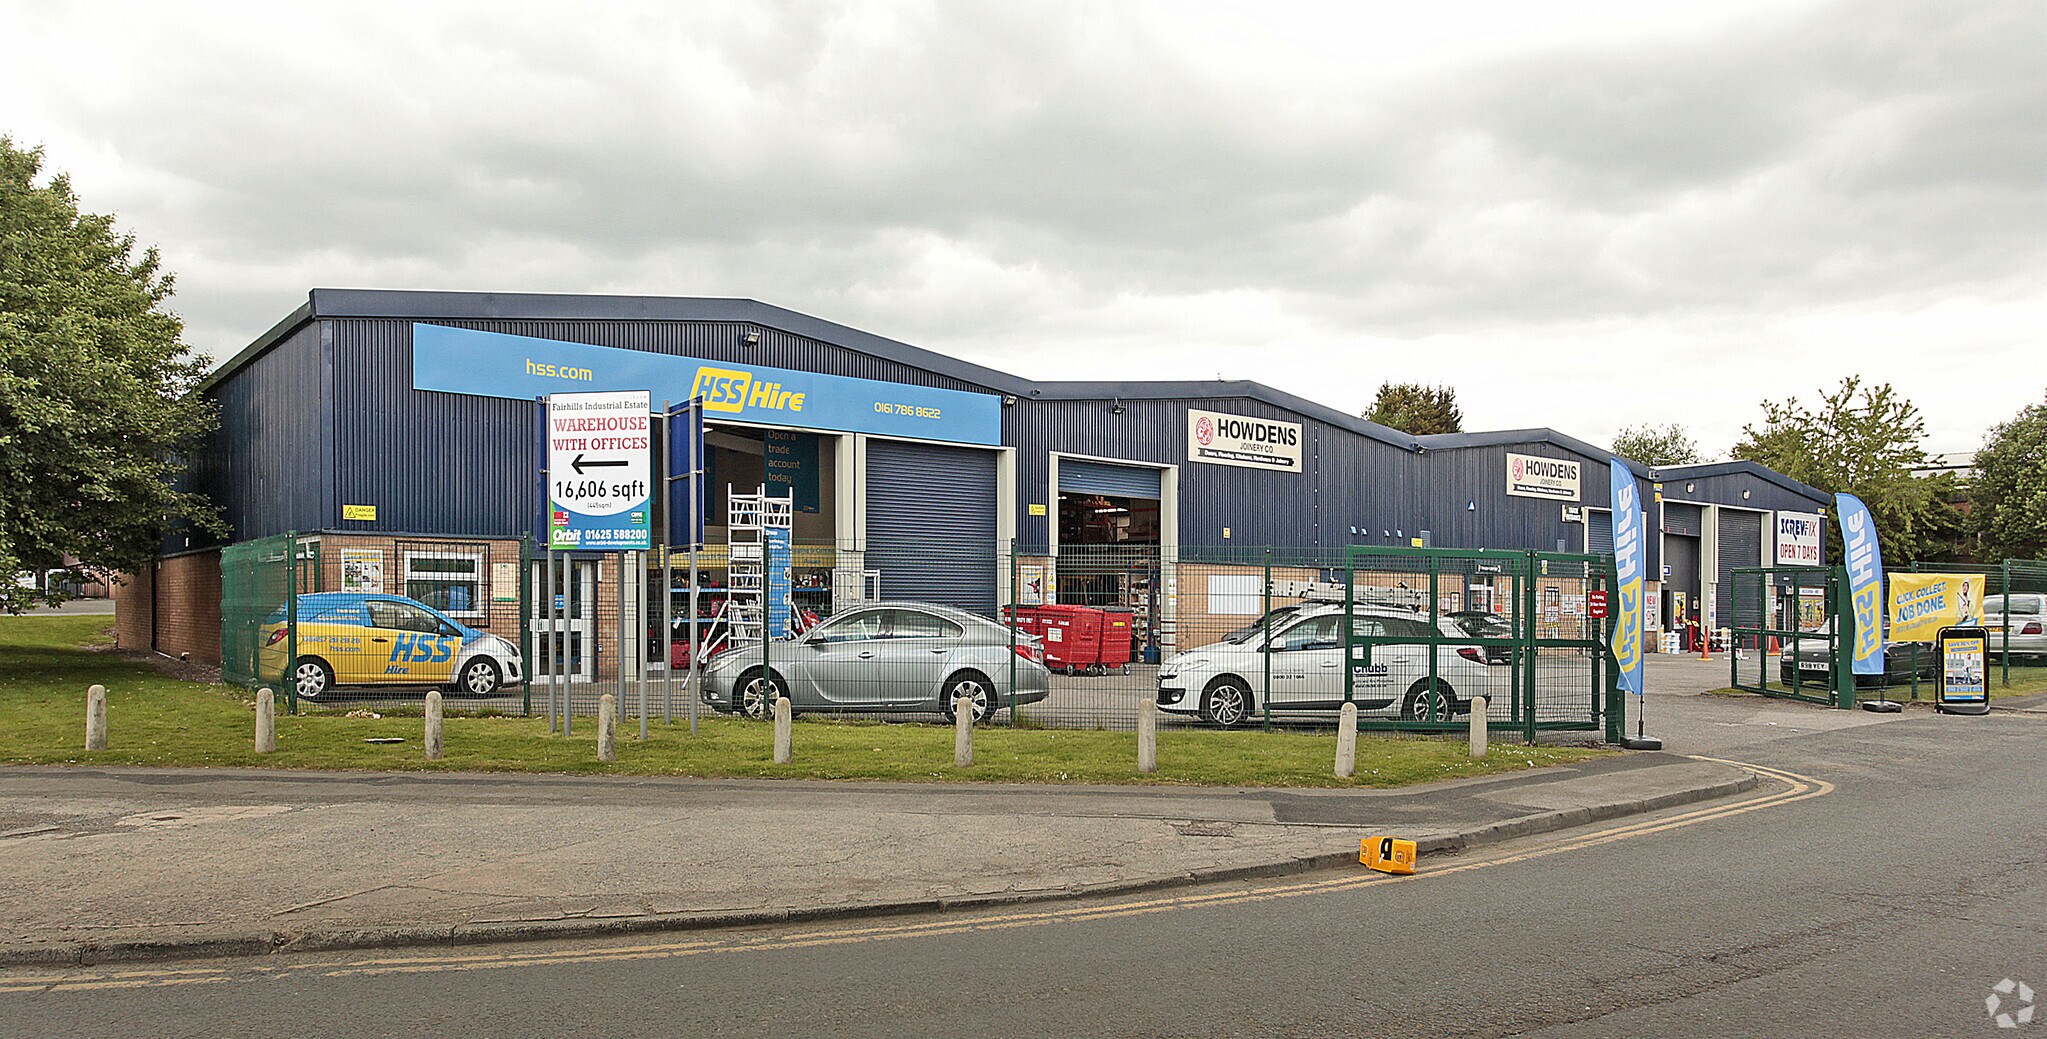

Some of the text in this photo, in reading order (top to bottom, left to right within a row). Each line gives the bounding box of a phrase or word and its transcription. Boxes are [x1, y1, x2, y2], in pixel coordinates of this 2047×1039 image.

[526, 358, 593, 381] hss.com
[696, 375, 806, 412] HSS Hire
[552, 400, 648, 411] Fairhills Industrial Estate
[874, 402, 941, 420] 0161 786 8622
[553, 416, 647, 432] WAREHOUSE
[768, 430, 789, 441] Open
[1217, 418, 1297, 447] HOWDENS
[553, 437, 648, 451] WITH OFFICES
[768, 444, 790, 454] trade
[1240, 442, 1263, 453] JOINERY
[768, 459, 801, 469] account
[1526, 459, 1577, 480] HOWDENS
[768, 472, 792, 484] today
[556, 479, 644, 501] 16,606 sqft
[552, 529, 647, 541] Orbit 01625 588200
[1781, 543, 1817, 560] OPEN 7 DAYS
[1896, 595, 1947, 623] JOB DONE.
[389, 633, 454, 663] HSS
[385, 664, 409, 674] Hire
